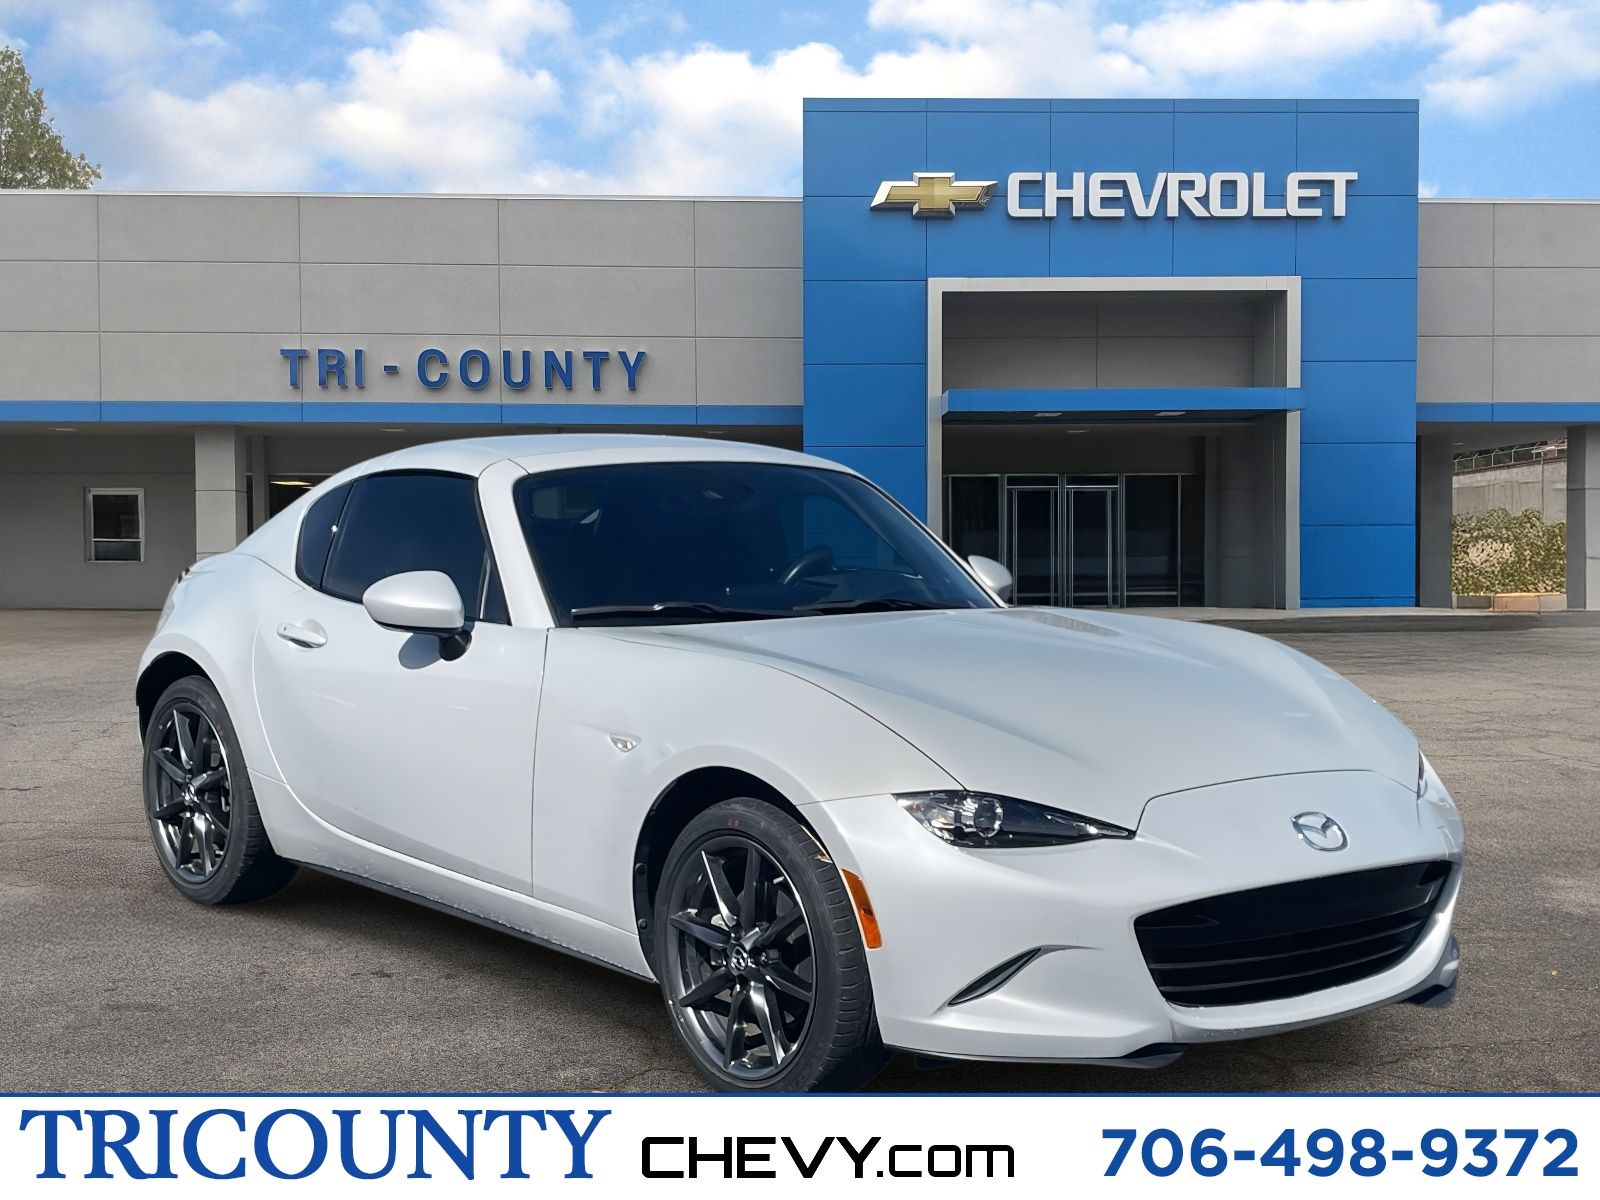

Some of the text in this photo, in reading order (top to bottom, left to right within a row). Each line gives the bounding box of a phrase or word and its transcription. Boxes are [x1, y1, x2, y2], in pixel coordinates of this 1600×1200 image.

[1006, 171, 1359, 219] CHEVROLET
[280, 348, 367, 389] TRI
[417, 348, 647, 391] COUNTY
